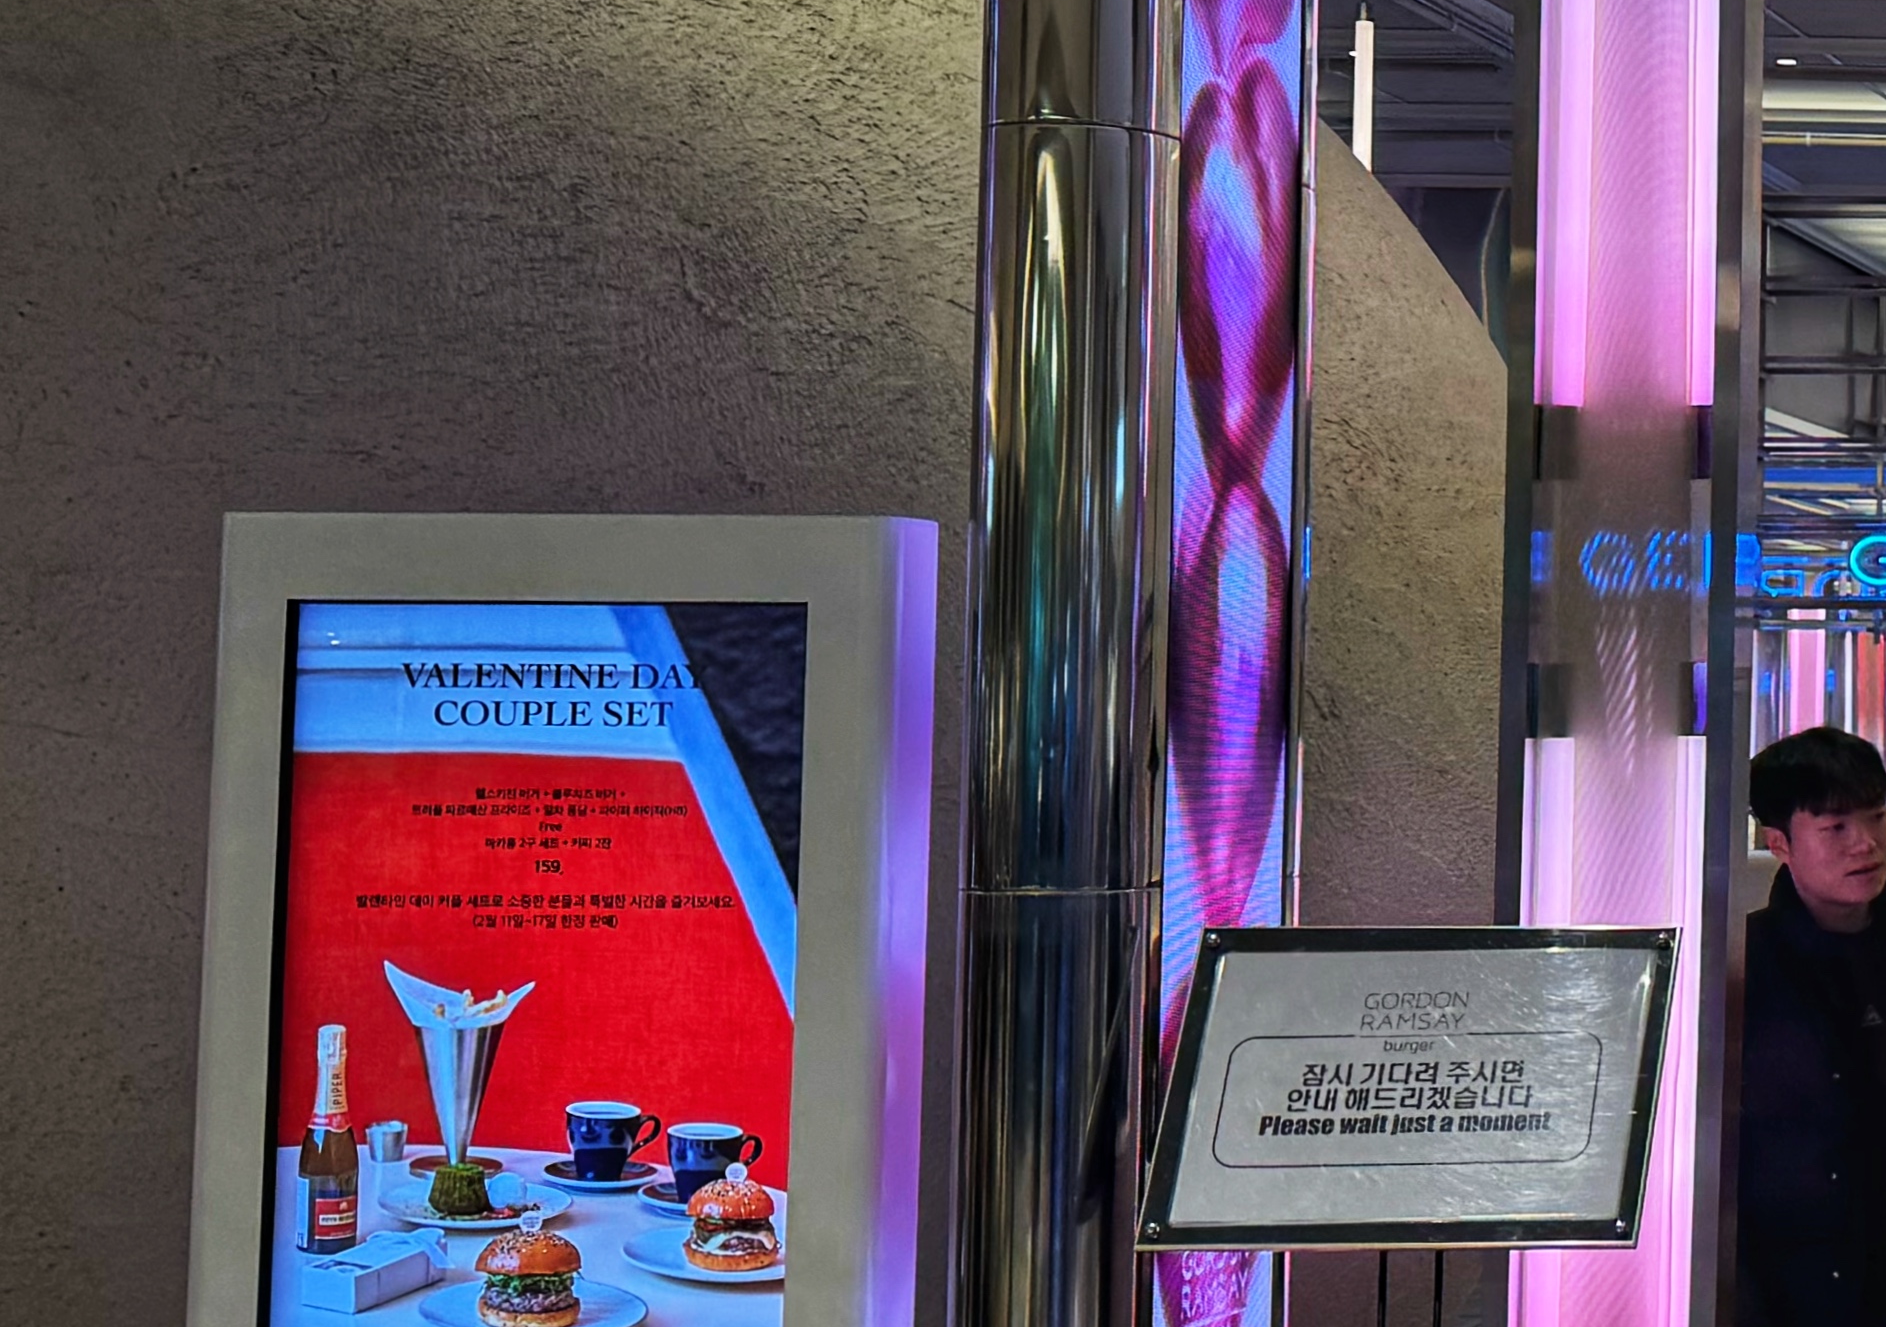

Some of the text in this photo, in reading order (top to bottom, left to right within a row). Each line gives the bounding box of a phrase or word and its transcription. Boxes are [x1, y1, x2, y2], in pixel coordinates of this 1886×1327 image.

[402, 662, 621, 690] VALENTINE
[433, 699, 674, 727] COUPLE SET
[538, 822, 563, 832] Free
[355, 894, 407, 908] 발렌타인
[408, 894, 435, 908] 데이
[437, 894, 463, 908] 커플
[466, 894, 504, 908] 세트로
[506, 894, 545, 908] 소중한
[589, 894, 627, 909] 특별한
[629, 894, 668, 909] 시간을
[1363, 991, 1470, 1011] GORDON
[1359, 1012, 1467, 1031] RAMSAY
[1382, 1039, 1436, 1054] burger
[1301, 1059, 1526, 1088] 잠시 기다려 주시면
[1286, 1084, 1534, 1113] 안내 해드리겠습니다
[1257, 1111, 1551, 1137] Please wait just a moment
